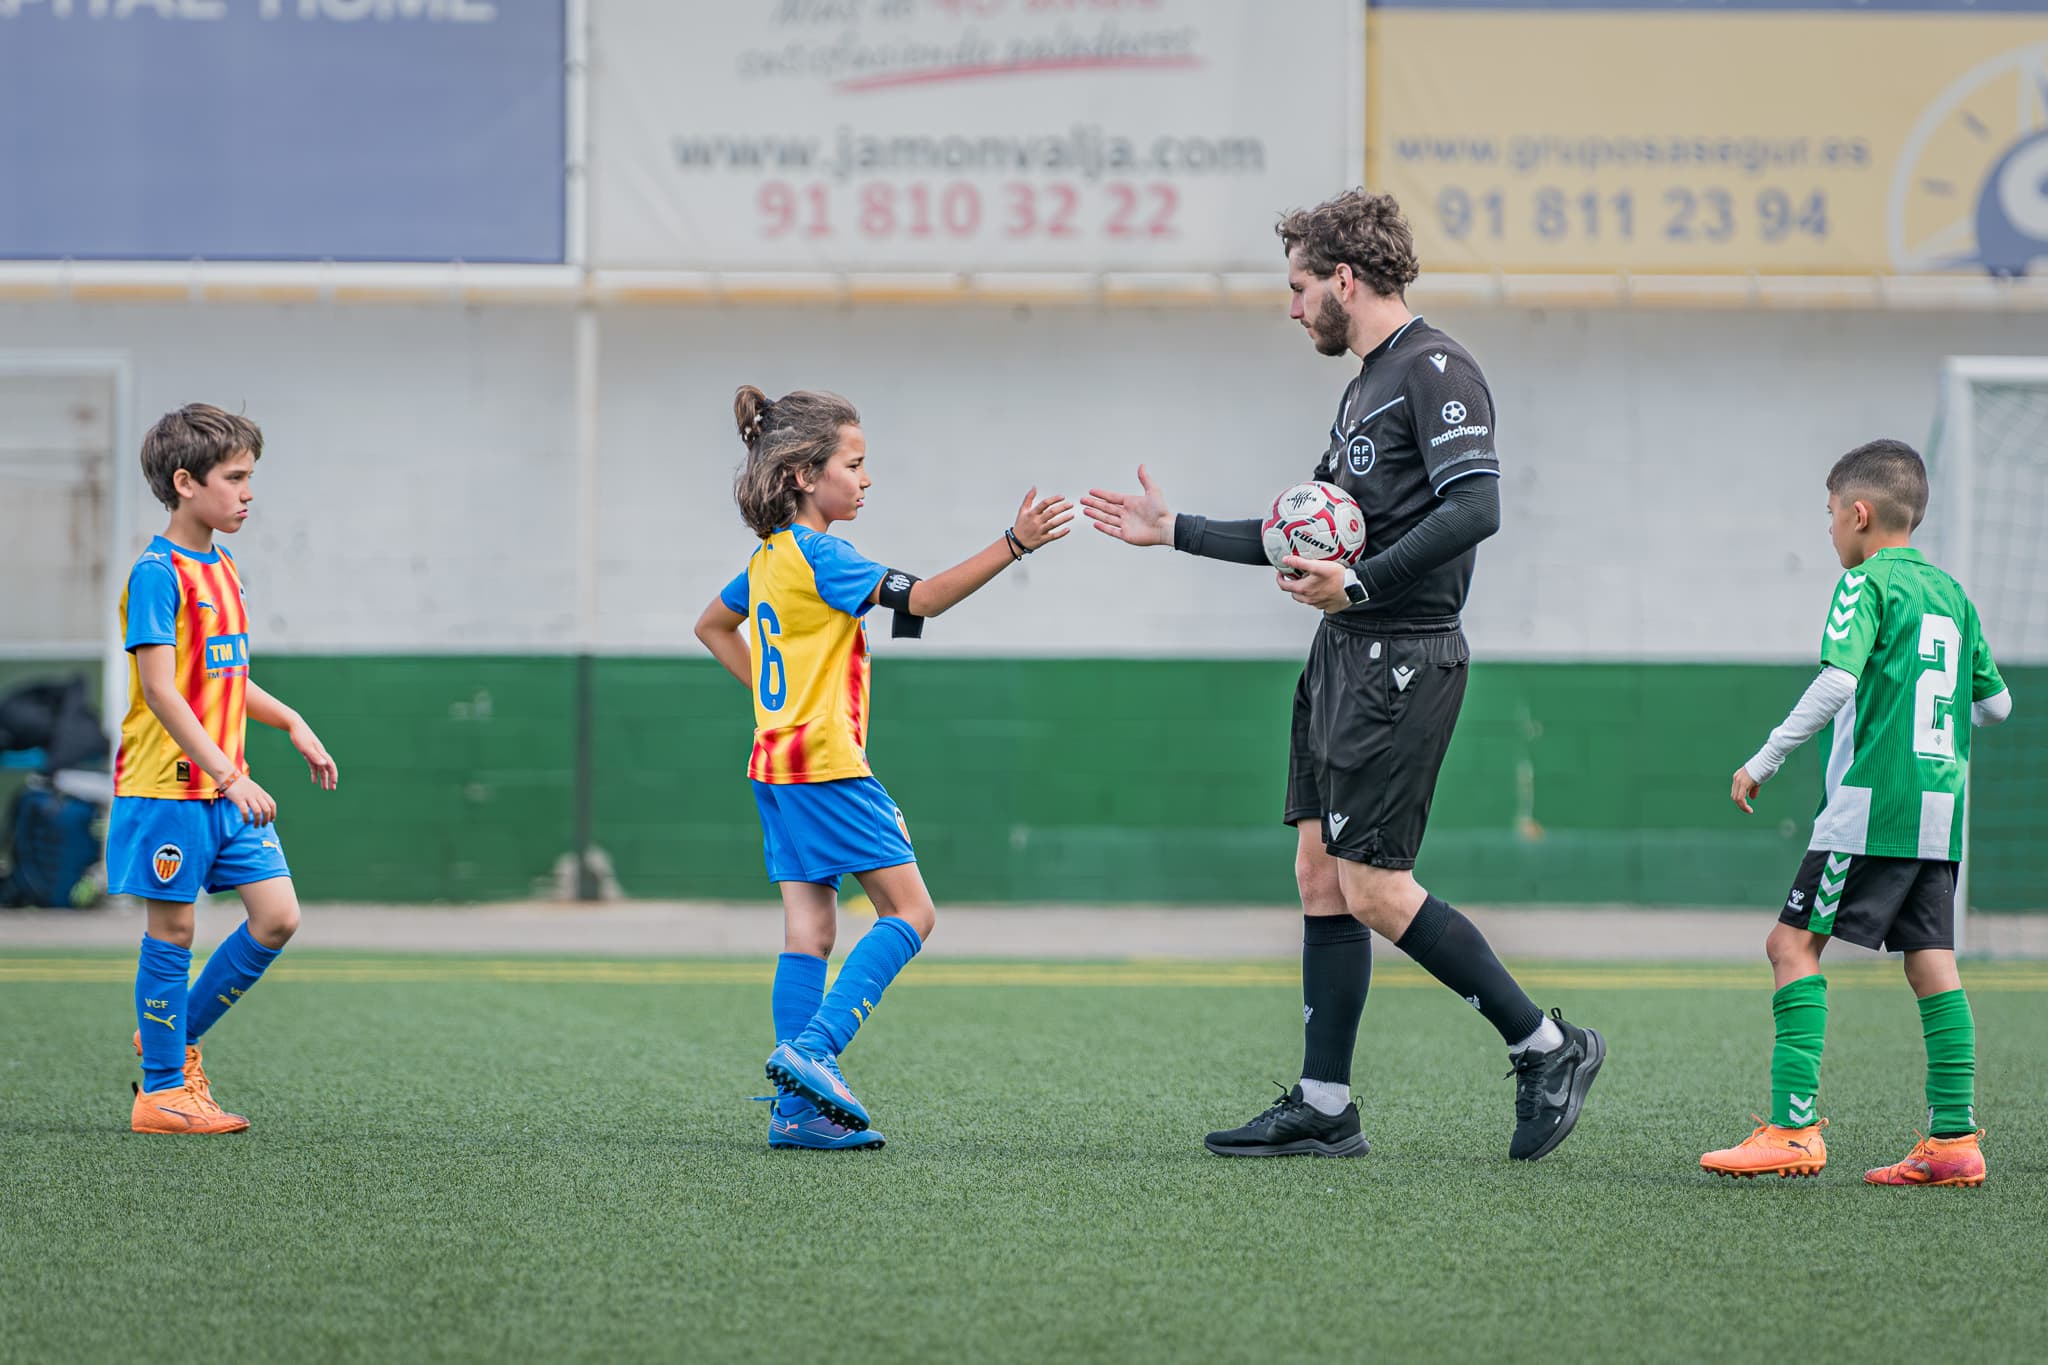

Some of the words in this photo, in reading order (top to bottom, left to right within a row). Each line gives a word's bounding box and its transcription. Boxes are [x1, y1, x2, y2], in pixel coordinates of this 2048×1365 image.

[670, 124, 1266, 182] www.jamonvalja.com
[1395, 135, 1872, 176] www.gruposasegur.es
[755, 181, 832, 240] 91
[857, 181, 983, 240] 810
[1002, 181, 1081, 240] 32
[1103, 181, 1181, 240] 22
[1437, 187, 1504, 240] 91
[1533, 187, 1635, 240] 811
[1662, 187, 1735, 240] 23
[1755, 187, 1829, 242] 94
[1353, 445, 1369, 455] RF
[1430, 425, 1489, 447] matchapp
[1353, 456, 1369, 466] EF
[208, 643, 234, 662] TM
[756, 601, 787, 712] 6
[1912, 613, 1963, 763] 2
[144, 997, 169, 1009] VCF
